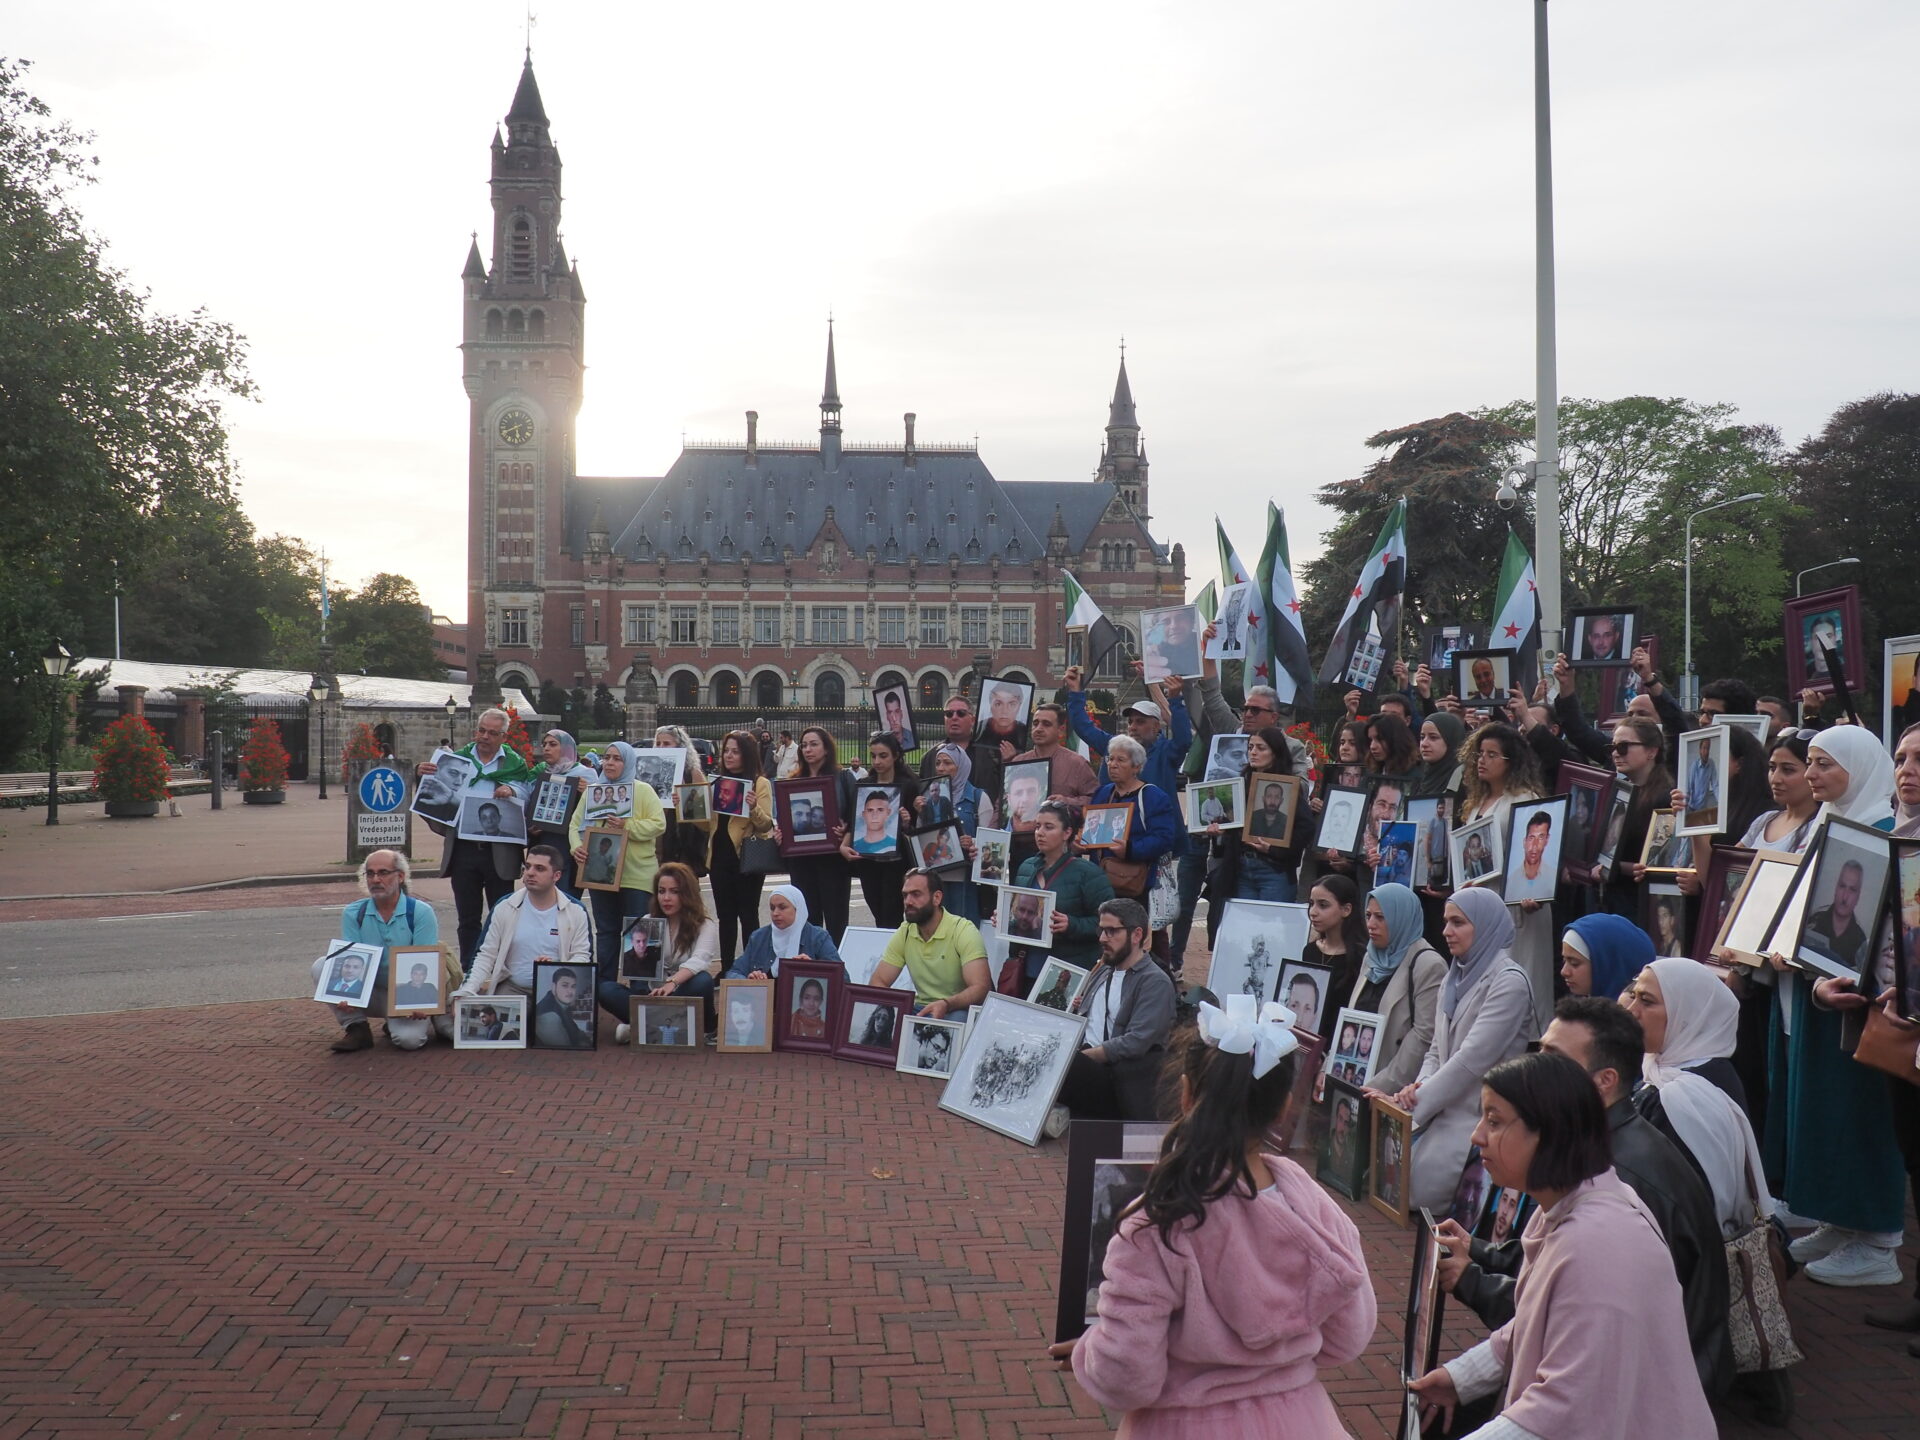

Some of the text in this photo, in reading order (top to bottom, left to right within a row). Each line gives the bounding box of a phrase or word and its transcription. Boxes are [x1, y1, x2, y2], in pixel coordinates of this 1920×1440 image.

[360, 816, 388, 824] Inrijden
[360, 825, 404, 833] Vredespaleis
[362, 836, 402, 844] toegestaan
